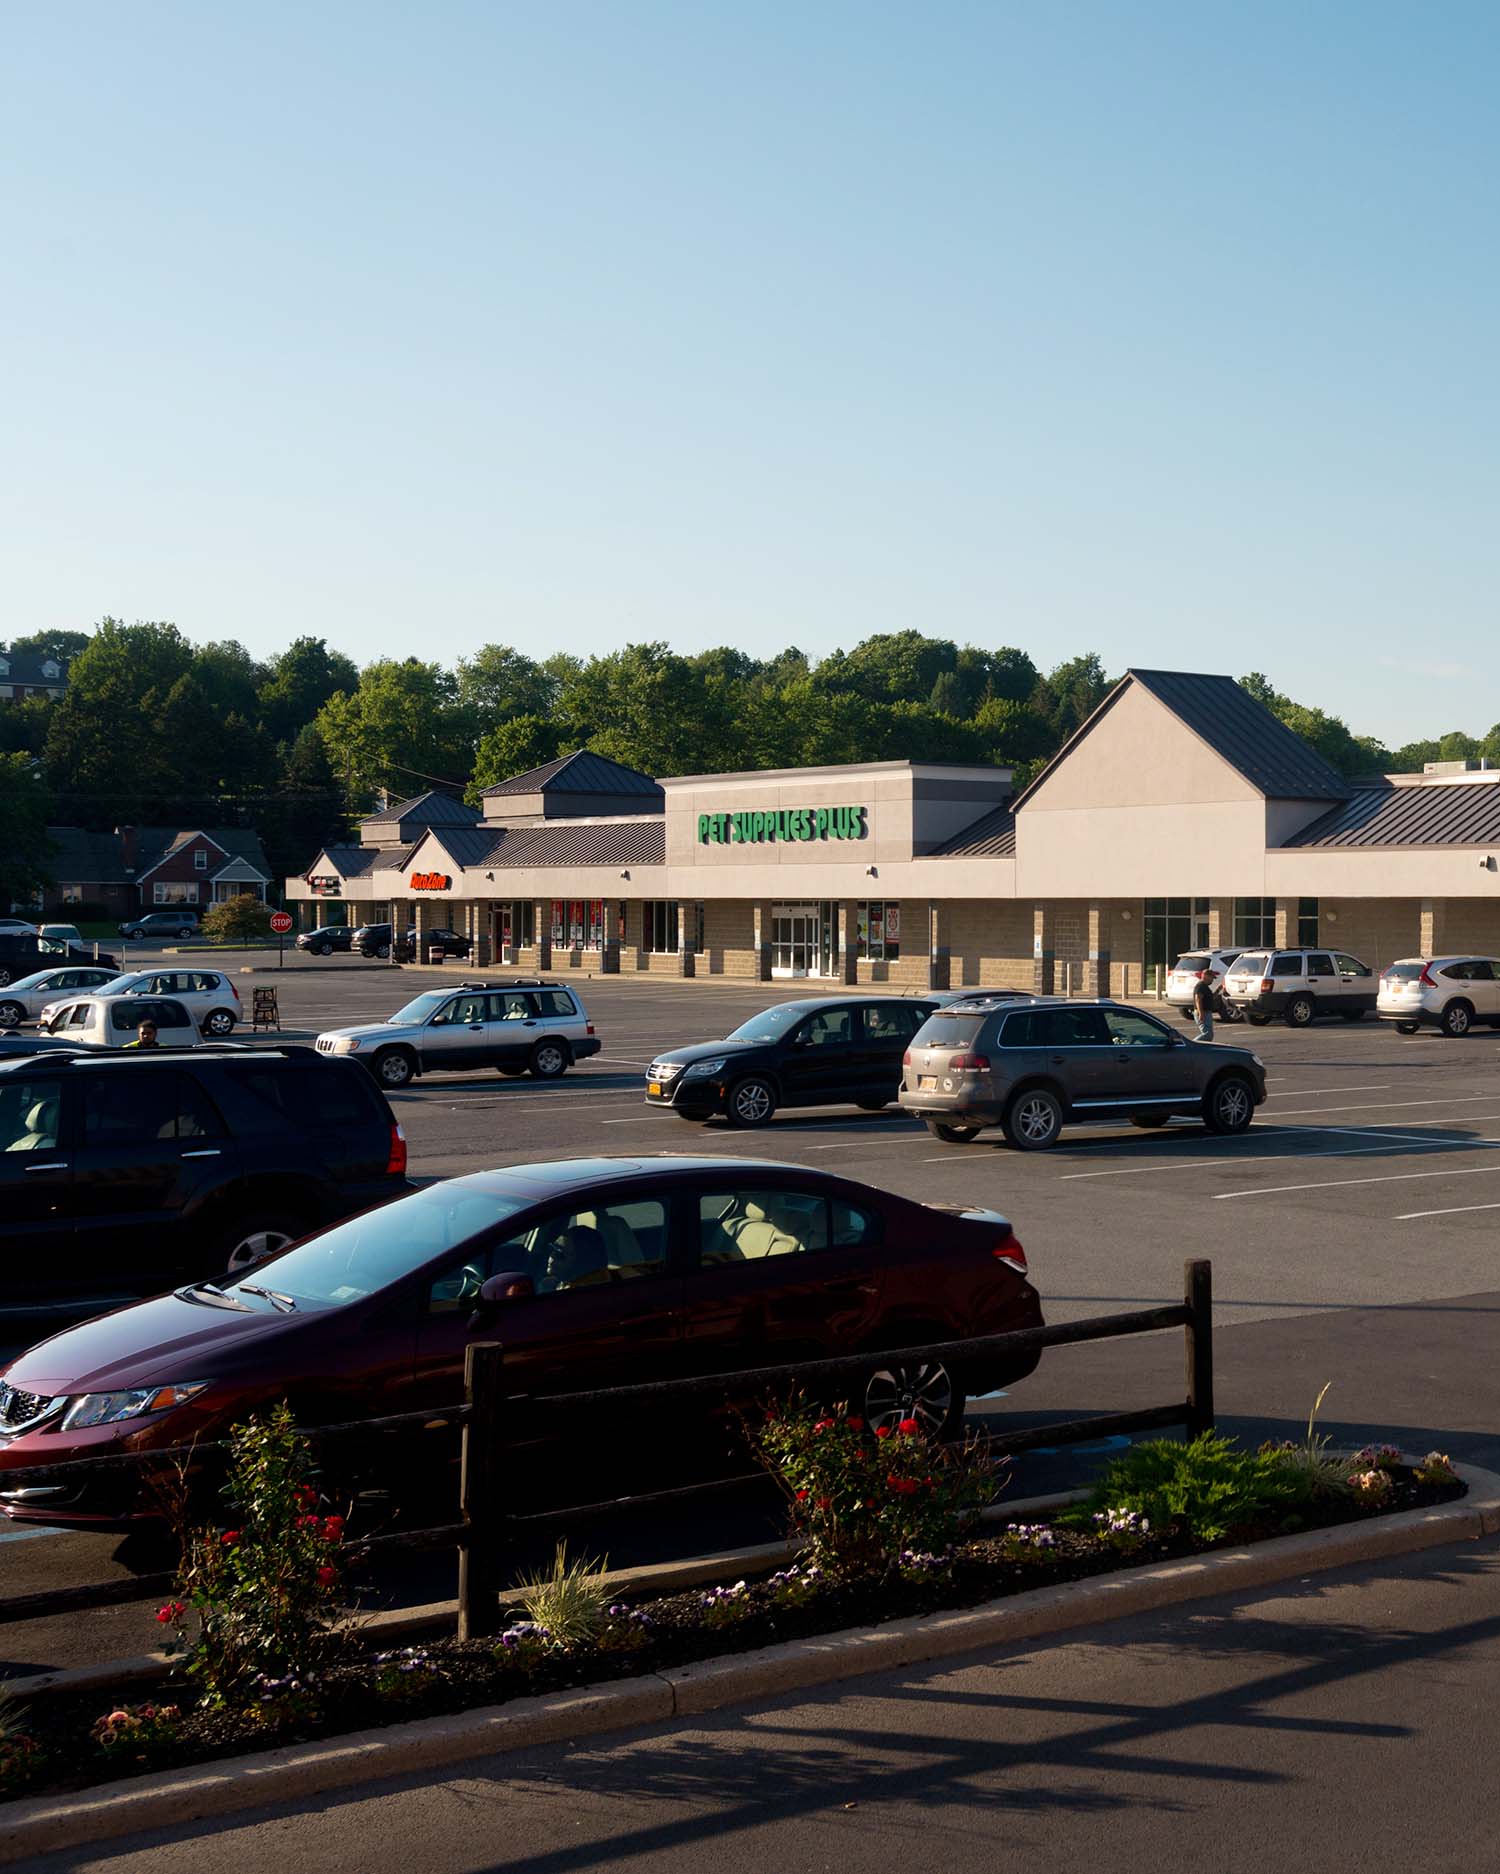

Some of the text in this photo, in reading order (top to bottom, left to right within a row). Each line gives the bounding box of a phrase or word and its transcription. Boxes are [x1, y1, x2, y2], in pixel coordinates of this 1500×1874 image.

[698, 806, 862, 843] PET SUPPLIES PLUS
[409, 872, 447, 890] AutoZone
[272, 918, 291, 927] STOP
